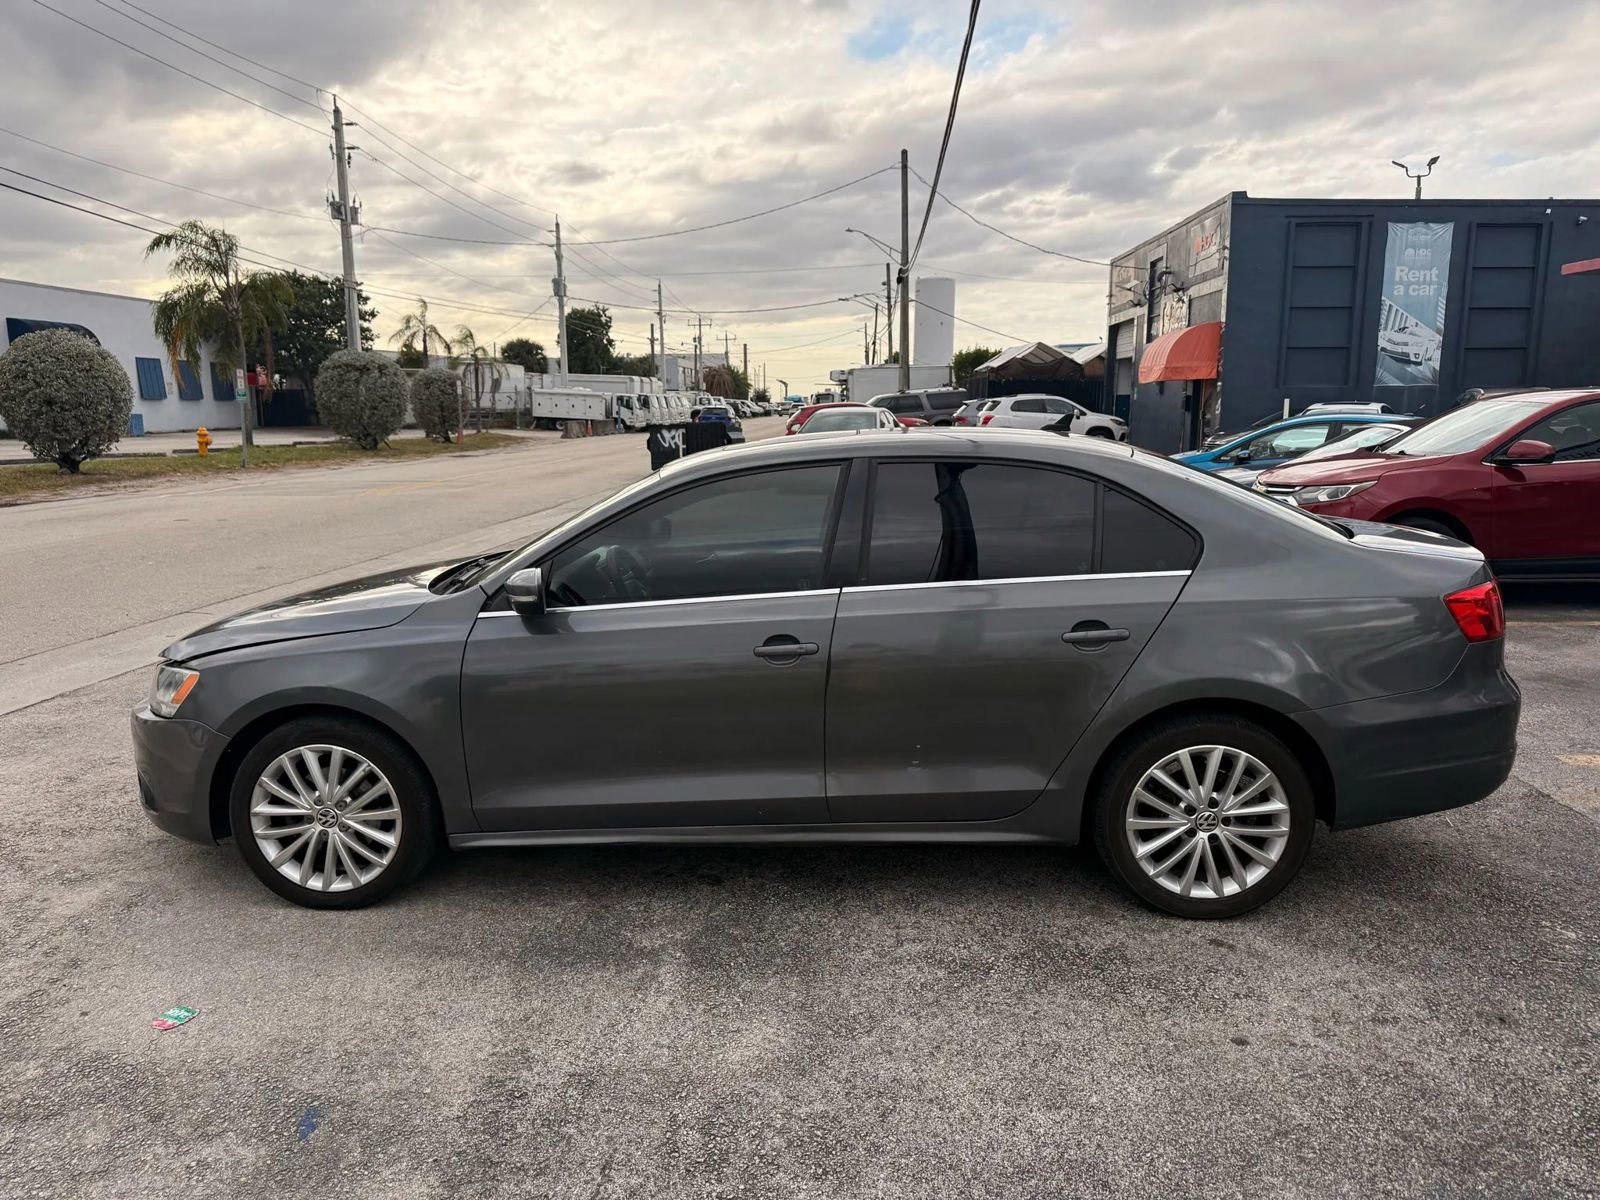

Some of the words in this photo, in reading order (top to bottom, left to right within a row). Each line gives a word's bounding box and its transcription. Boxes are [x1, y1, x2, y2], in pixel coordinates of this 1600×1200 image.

[1395, 266, 1439, 281] Rent
[1393, 285, 1404, 296] a
[1408, 285, 1438, 296] car
